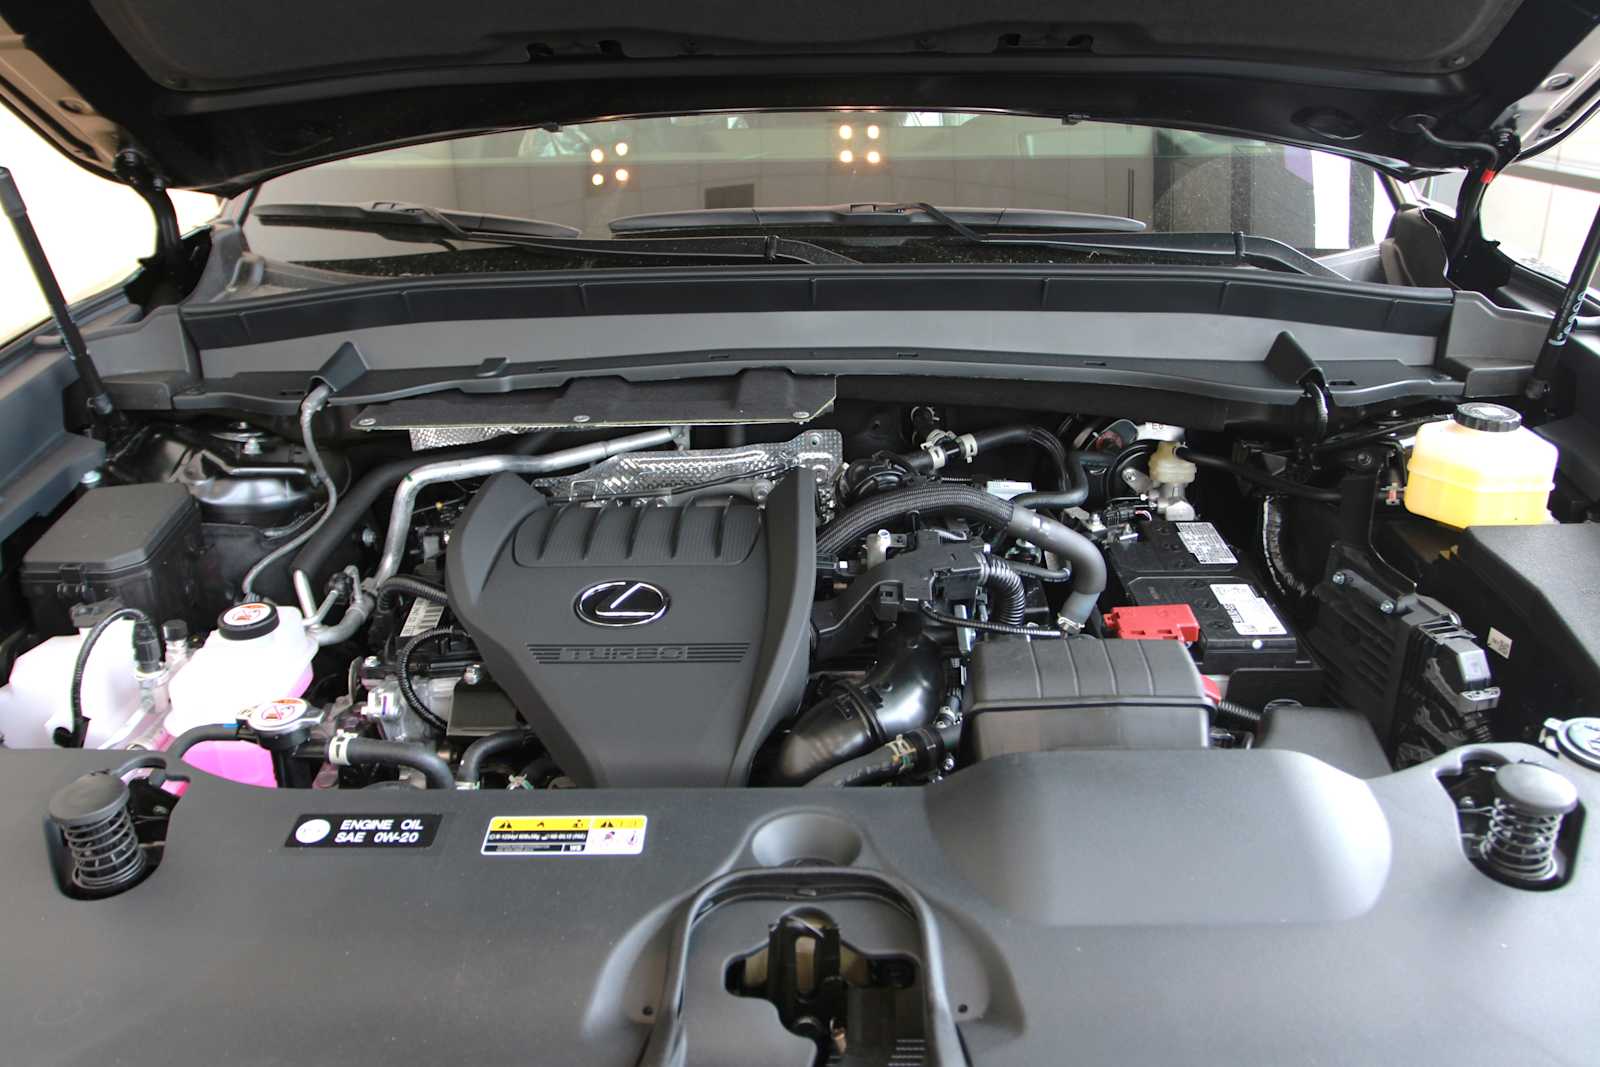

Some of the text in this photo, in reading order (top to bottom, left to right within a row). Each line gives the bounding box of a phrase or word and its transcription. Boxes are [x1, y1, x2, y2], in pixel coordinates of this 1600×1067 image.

[561, 646, 688, 661] TURBO
[340, 819, 423, 830] ENGINE OIL
[334, 832, 419, 843] SAE 0W-20
